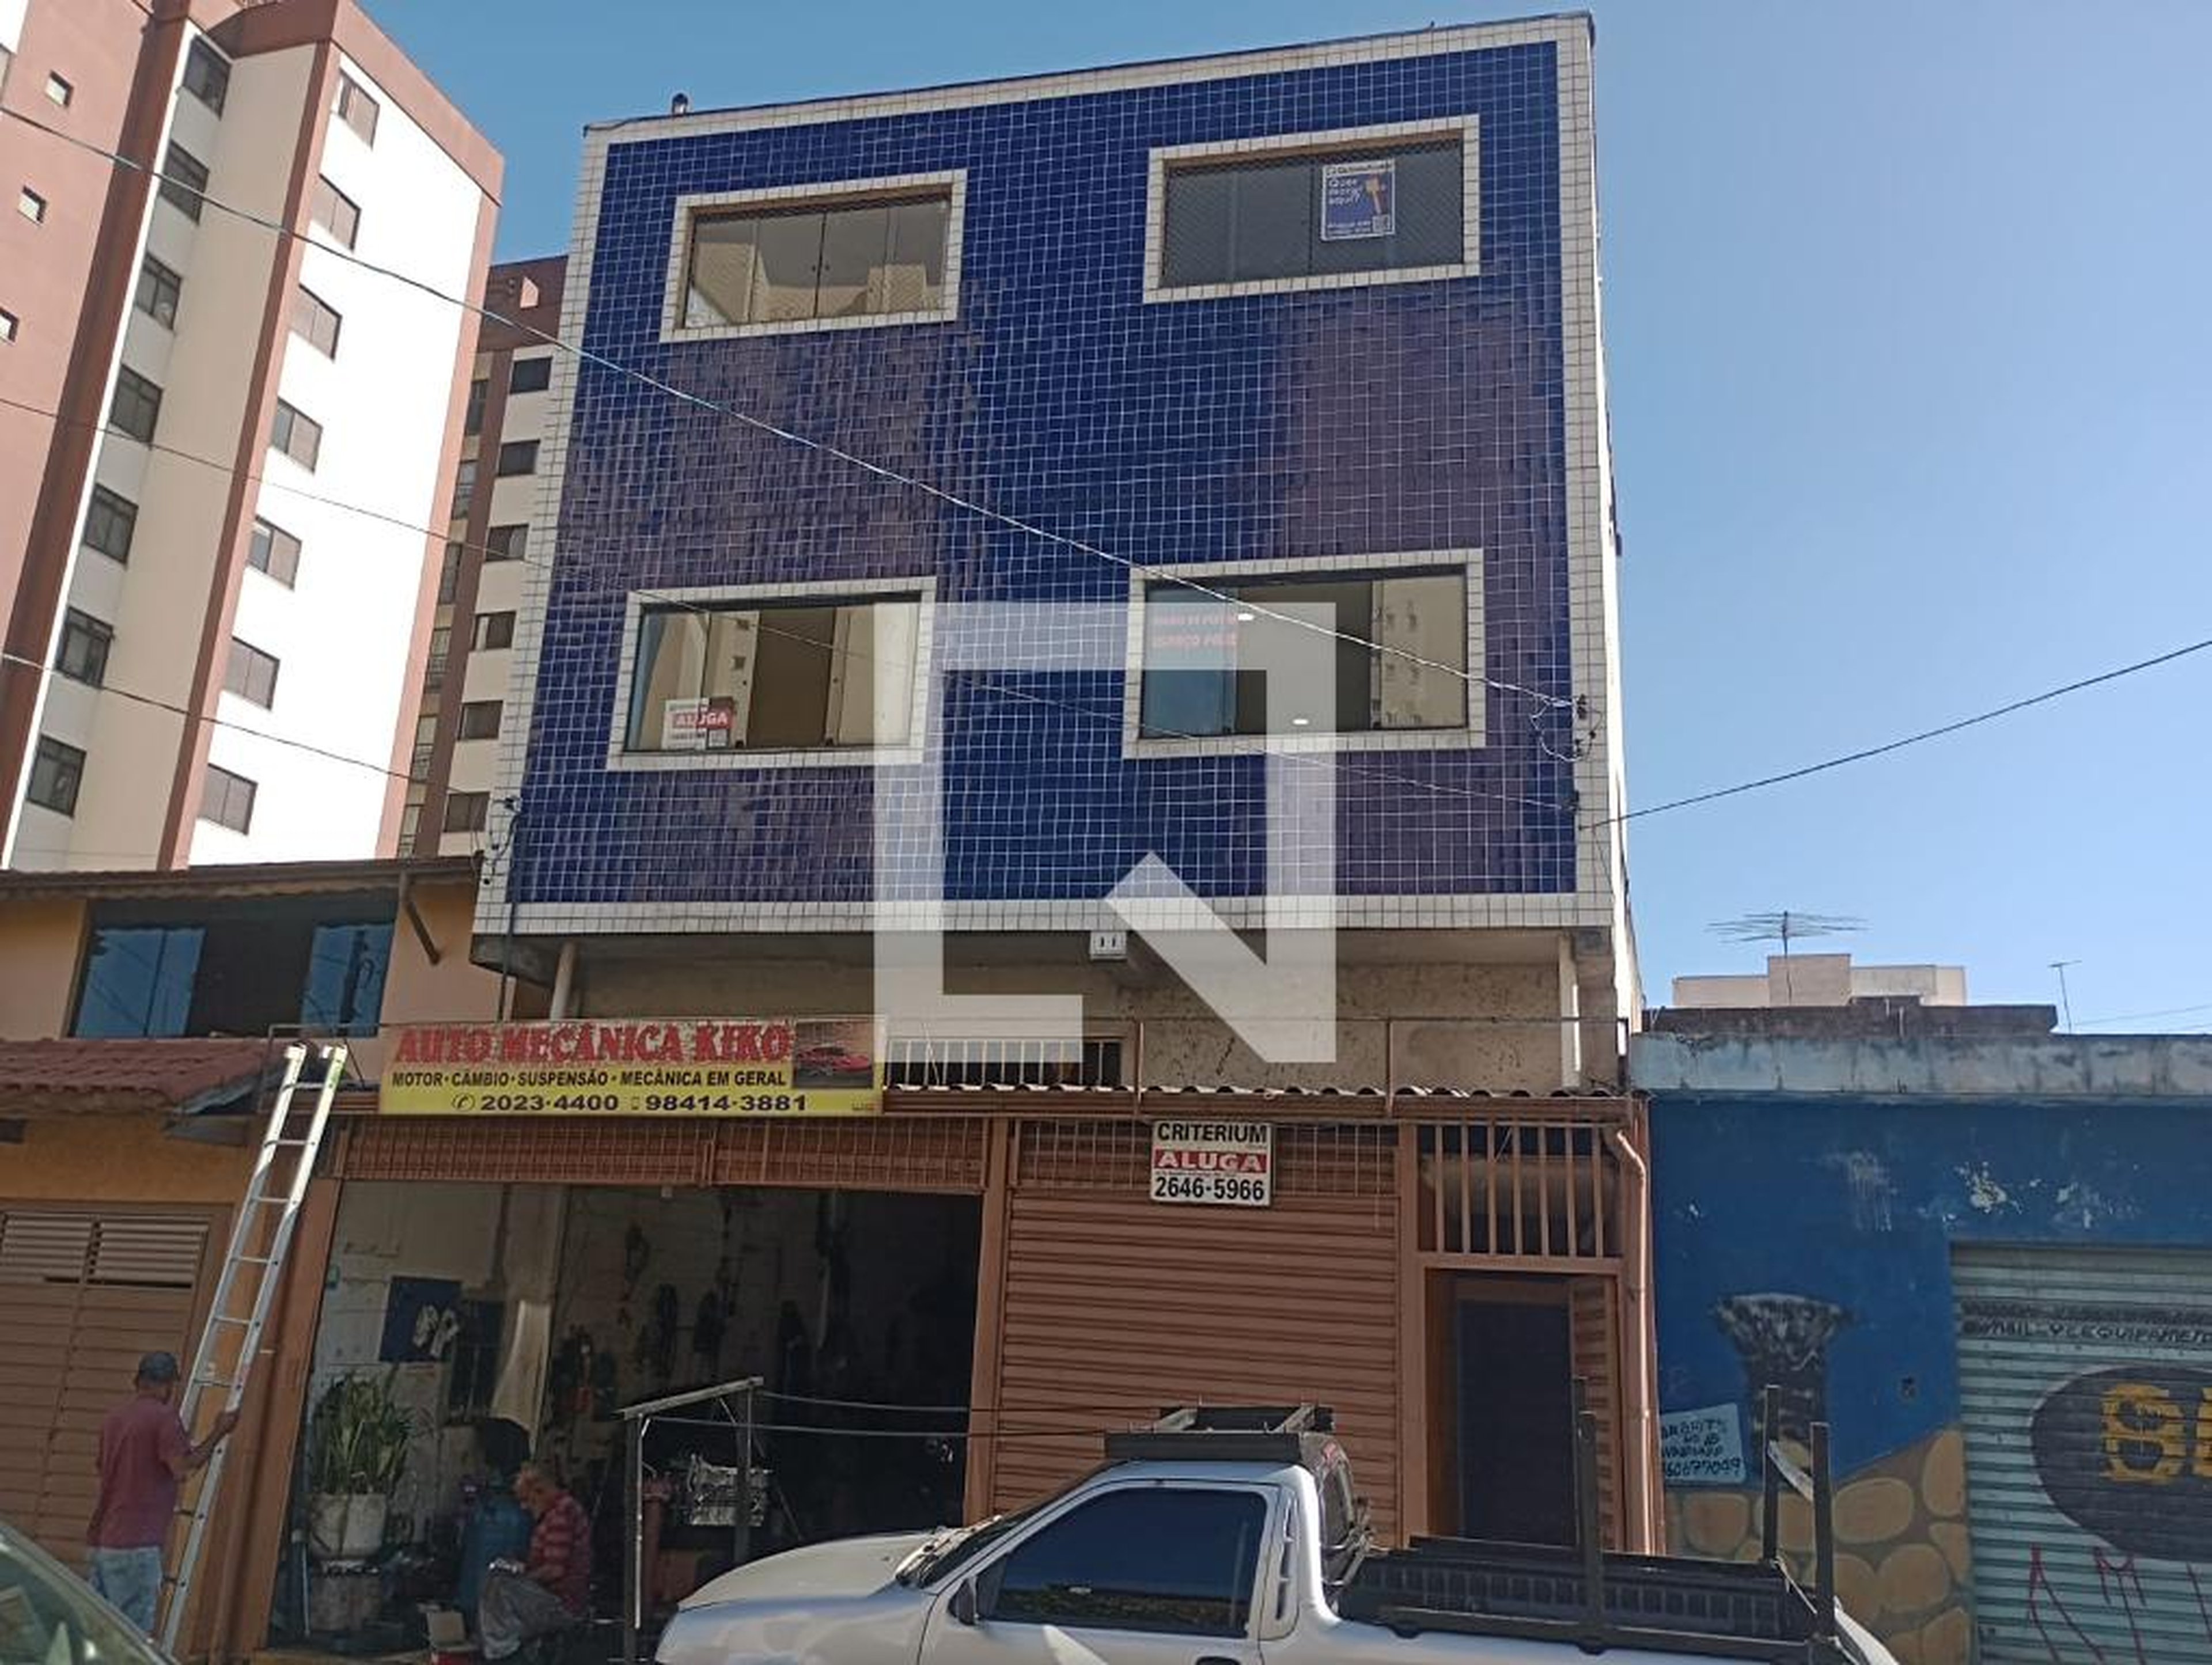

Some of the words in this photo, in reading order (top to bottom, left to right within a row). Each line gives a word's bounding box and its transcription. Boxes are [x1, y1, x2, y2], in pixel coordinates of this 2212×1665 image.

[676, 711, 728, 726] ALUGA
[395, 1026, 493, 1063] AUTO
[694, 1021, 794, 1062] KIKO
[392, 1072, 444, 1087] MOTOR
[517, 1068, 608, 1086] SUSPENSÃO
[620, 1068, 702, 1086] MECÂNICA
[707, 1071, 729, 1086] EM
[734, 1071, 786, 1086] GERAL
[1157, 1122, 1267, 1143] CRITERIUM
[1158, 1151, 1262, 1171] ALUGA
[1155, 1177, 1264, 1201] 2646-5966
